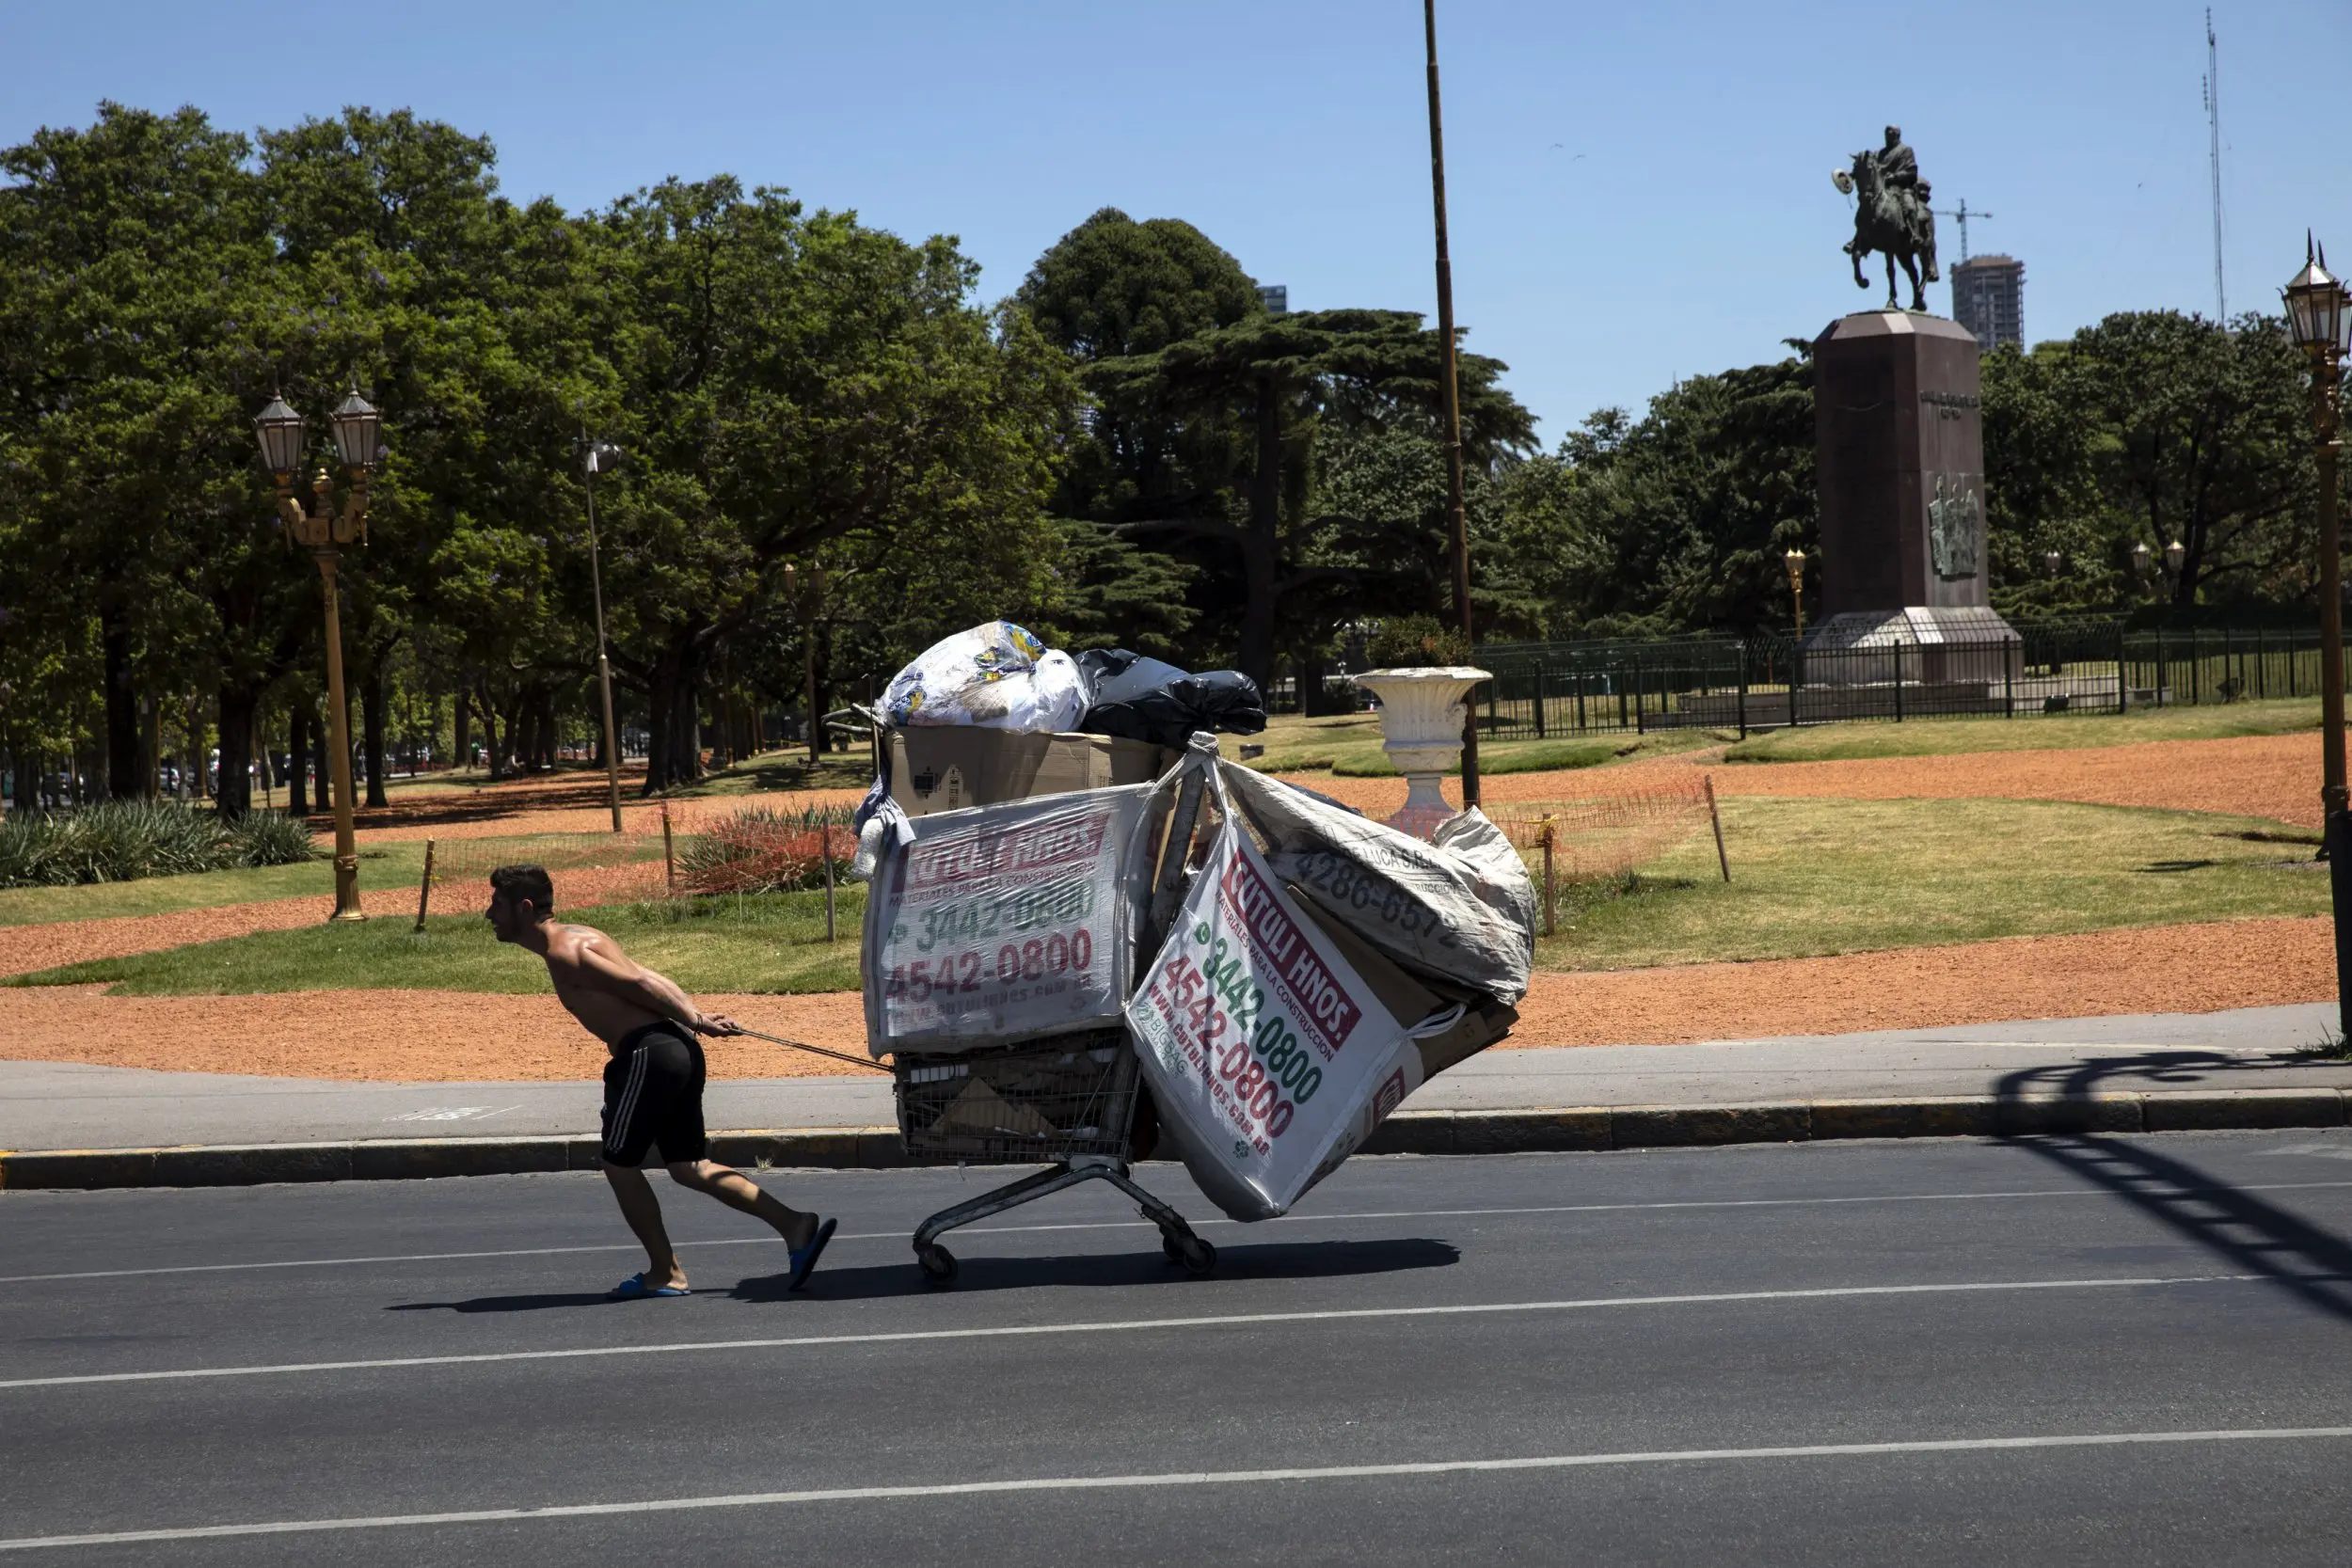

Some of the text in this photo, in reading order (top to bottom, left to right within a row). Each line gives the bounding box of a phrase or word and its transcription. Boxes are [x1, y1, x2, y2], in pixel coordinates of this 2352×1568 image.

[1295, 852, 1459, 949] 4286-6572
[1362, 847, 1400, 869] LUCA
[885, 927, 1091, 1005] 4542-0800
[1215, 889, 1334, 1063] MATERIALES PARA LA CONSTRUCCION
[1232, 861, 1349, 1040] CUTULI HNOS.
[1150, 1018, 1189, 1074] BIGBAG
[1165, 955, 1295, 1139] 4542-0800
[1202, 937, 1323, 1104] 3442-0800
